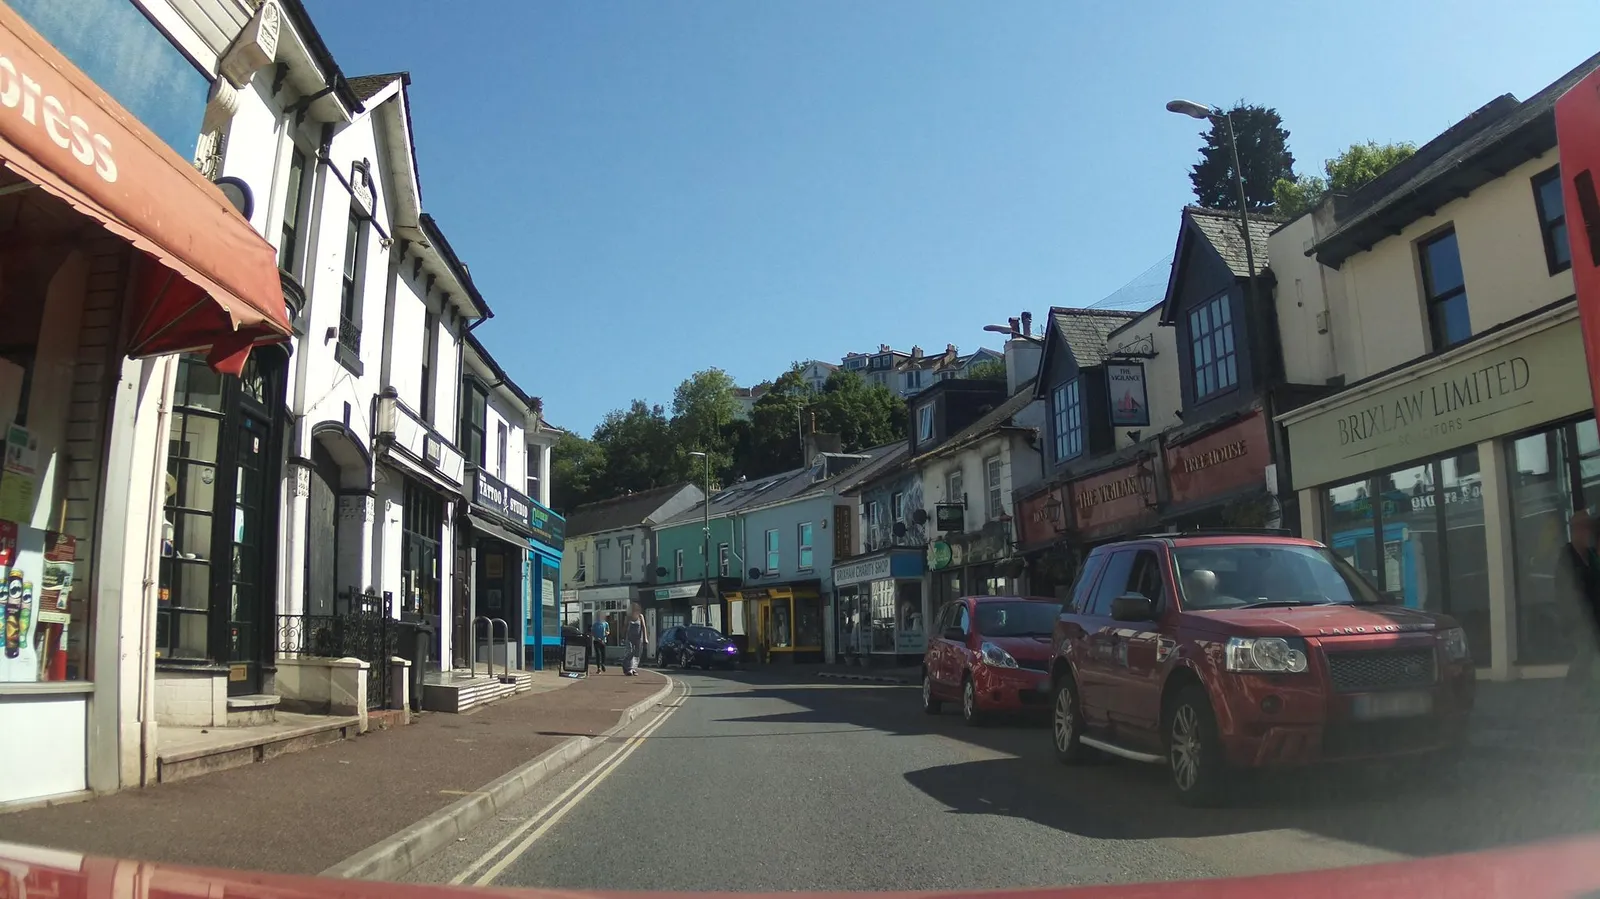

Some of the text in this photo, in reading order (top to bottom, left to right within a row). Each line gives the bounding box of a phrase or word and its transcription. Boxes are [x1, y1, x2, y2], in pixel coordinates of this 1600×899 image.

[1338, 356, 1530, 446] BRIXLAW LIMITED
[1399, 417, 1463, 446] SOCITORS
[1183, 440, 1247, 473] FREE HOUSE
[480, 480, 502, 505] TATTOO
[510, 498, 528, 519] STUDIO
[1078, 474, 1140, 509] THE VIGILAN
[836, 559, 889, 582] BRIXHAM CHARITY SHOP
[1320, 626, 1366, 634] LAND
